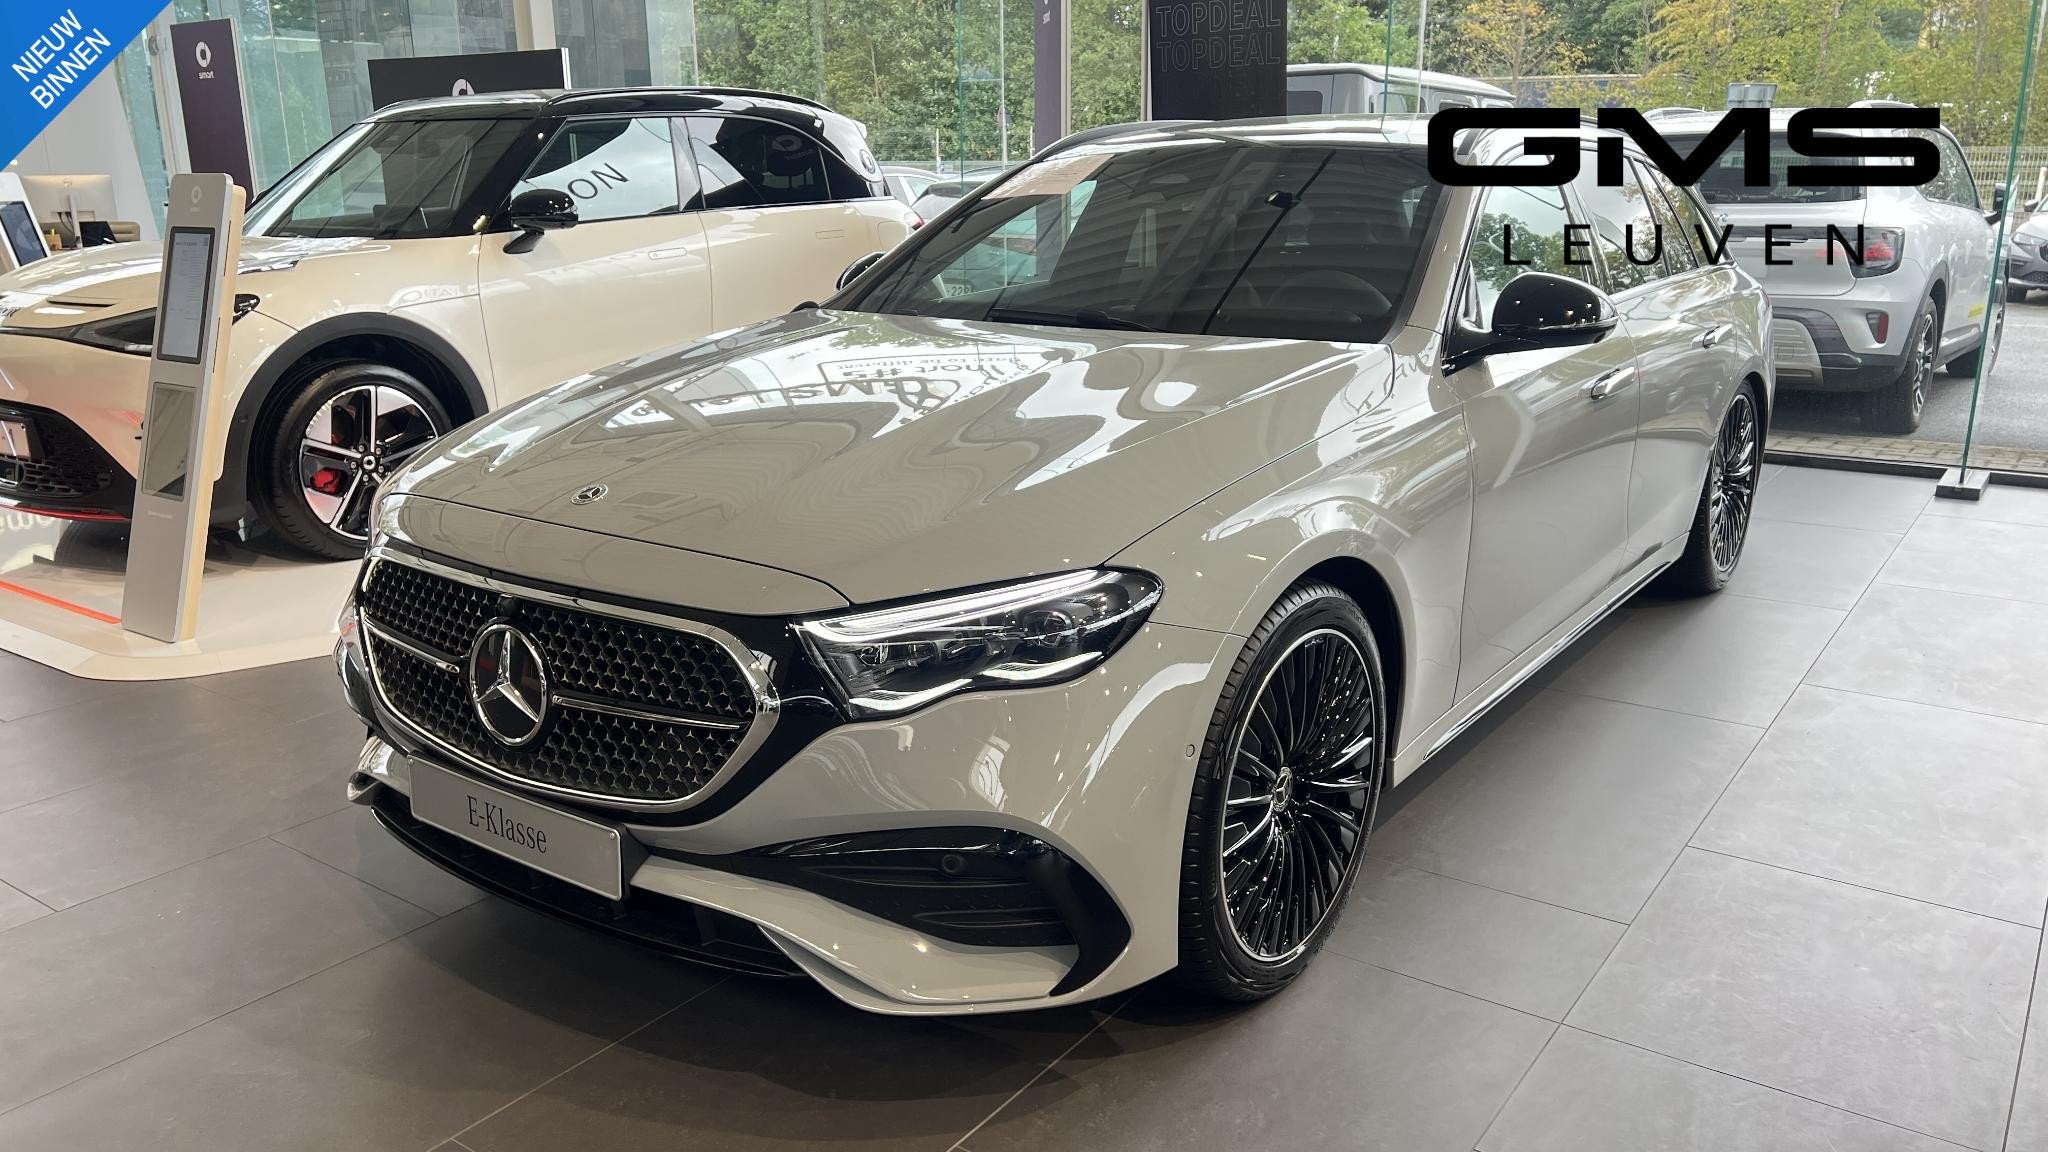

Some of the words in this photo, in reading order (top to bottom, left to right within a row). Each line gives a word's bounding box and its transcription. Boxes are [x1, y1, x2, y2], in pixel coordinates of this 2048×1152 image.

[1156, 0, 1281, 37] TOPDEAL
[1156, 32, 1280, 72] TOPDEAL
[466, 794, 548, 854] E-Klasse
